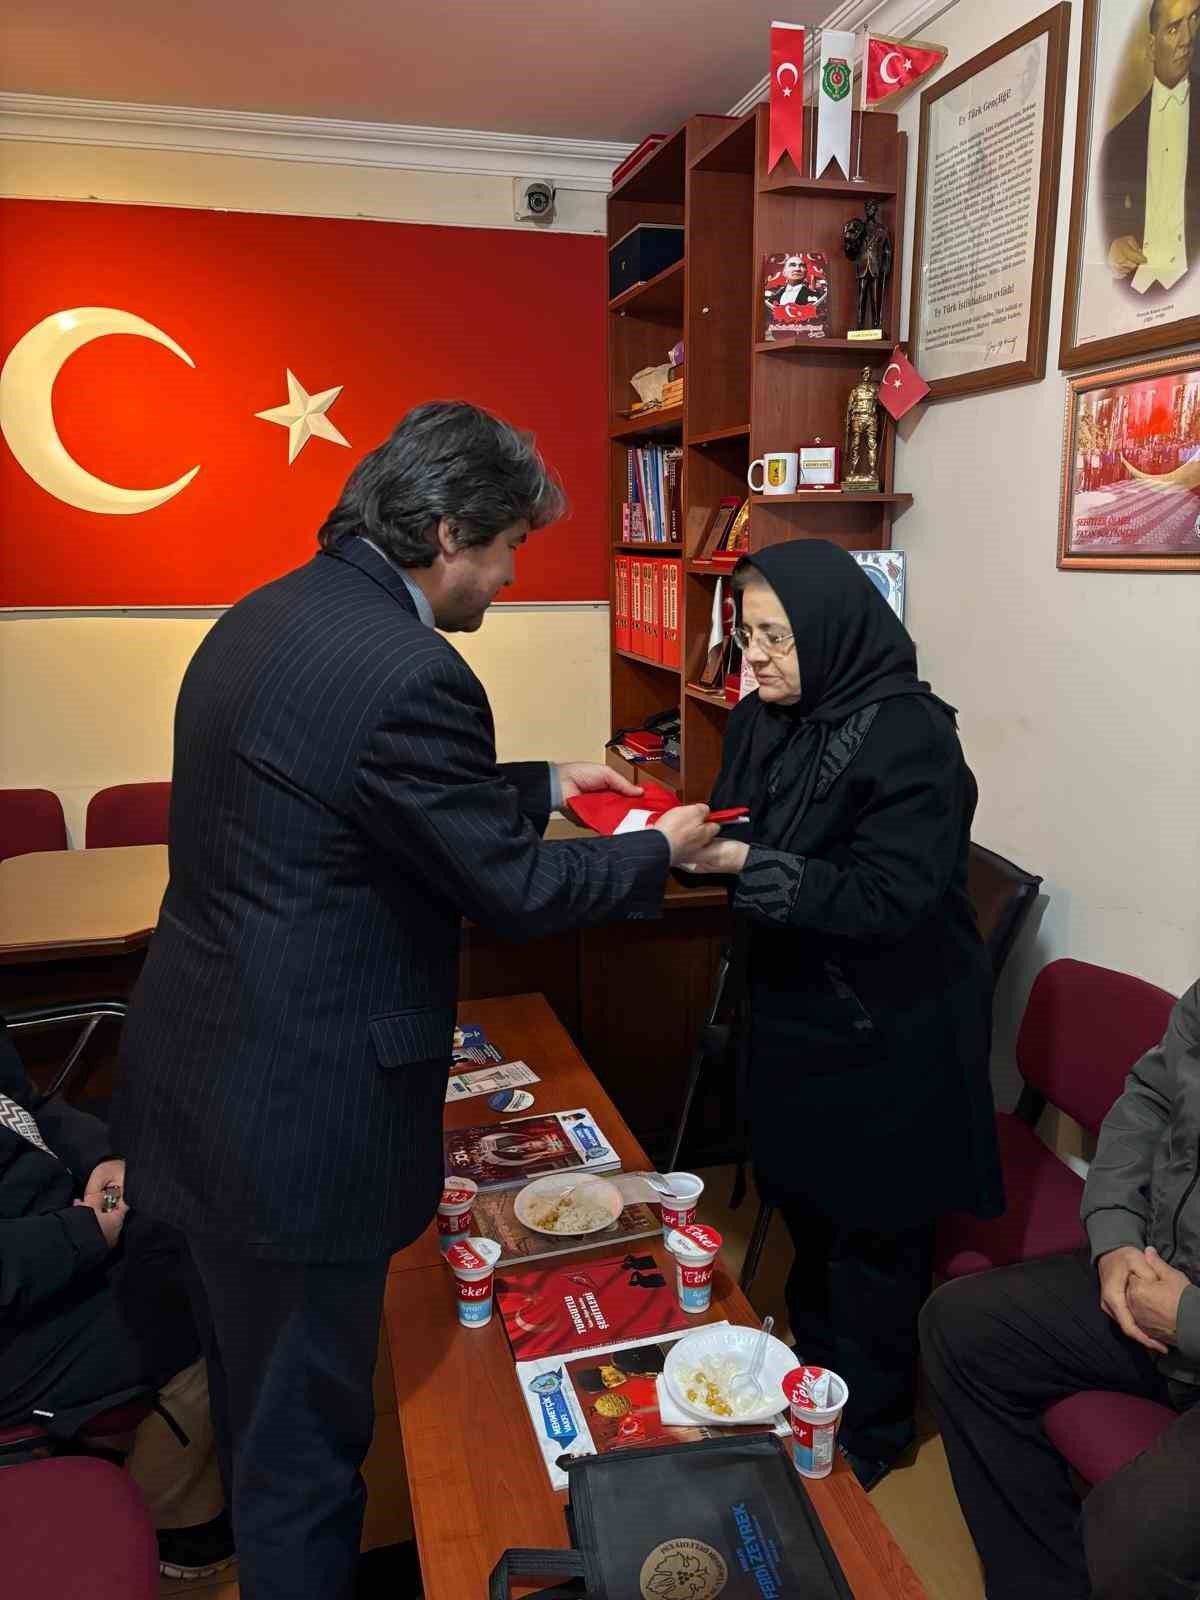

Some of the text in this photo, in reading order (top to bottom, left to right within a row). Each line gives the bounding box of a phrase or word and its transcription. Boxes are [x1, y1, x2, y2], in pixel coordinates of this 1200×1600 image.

[968, 107, 983, 121] Türk
[943, 303, 957, 315] Türk
[564, 1295, 587, 1335] TURGUTLU
[583, 1291, 609, 1330] ŞEHİTLERİ
[731, 1503, 762, 1567] ZEYREK
